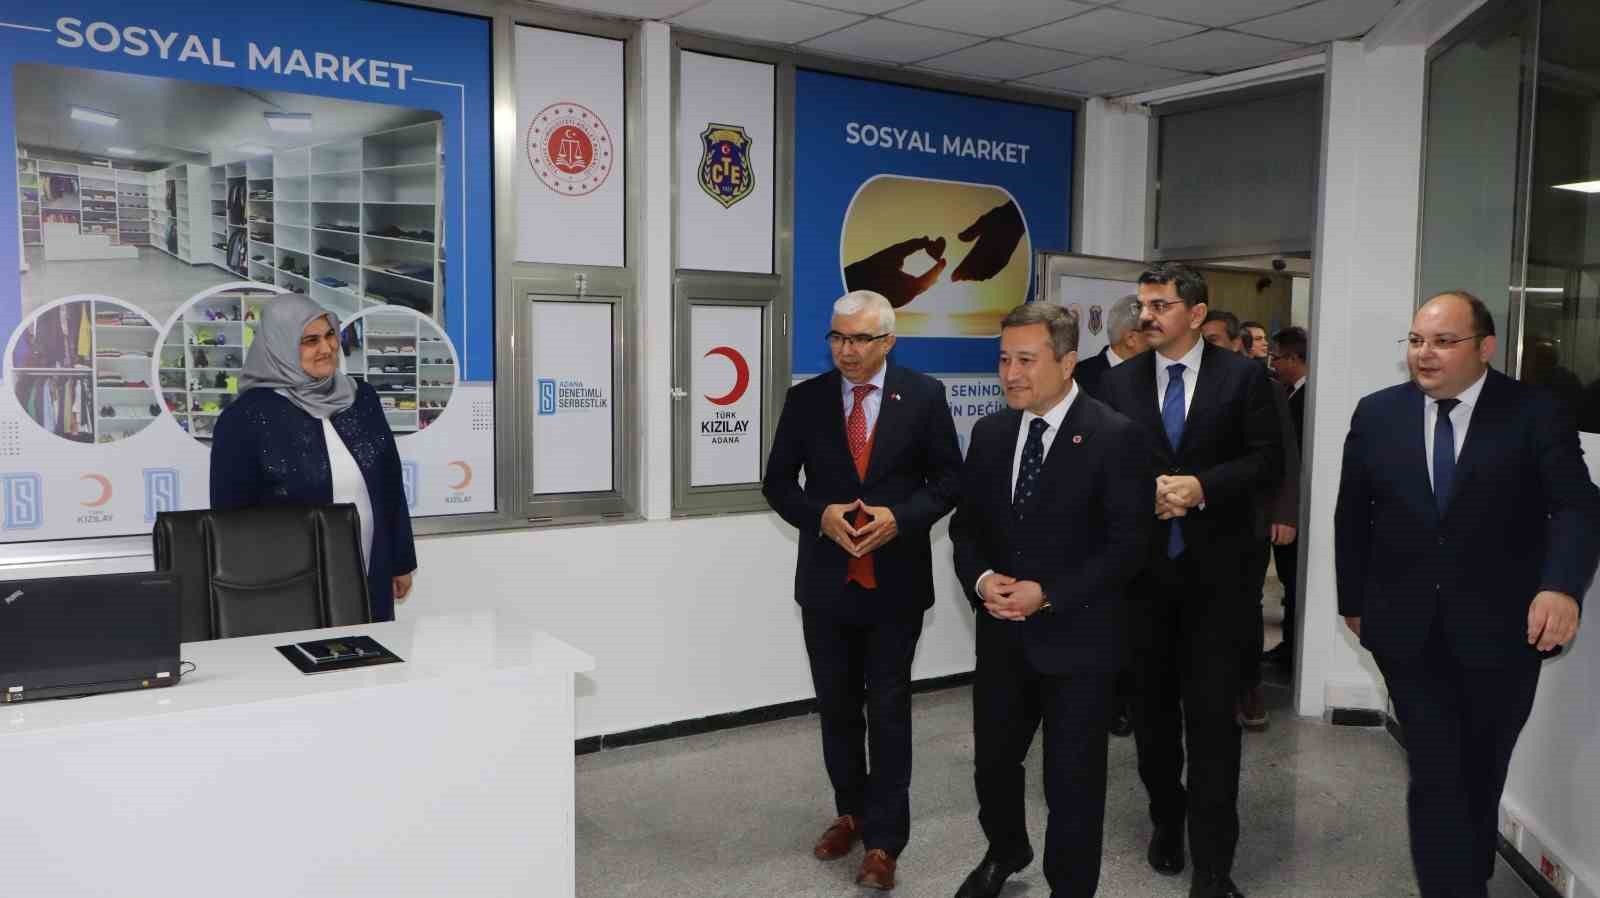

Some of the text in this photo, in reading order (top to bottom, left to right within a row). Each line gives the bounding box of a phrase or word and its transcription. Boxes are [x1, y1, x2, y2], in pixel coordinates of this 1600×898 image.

[57, 16, 413, 90] SOSYAL MARKET
[846, 121, 1030, 164] SOSYAL MARKET
[559, 387, 603, 398] DENETİMLİ
[951, 381, 1005, 397] SENİND
[559, 398, 607, 408] SERBESTLİK
[716, 410, 736, 419] TÜRK
[701, 420, 749, 433] KIZILAY
[712, 436, 739, 444] ADANA
